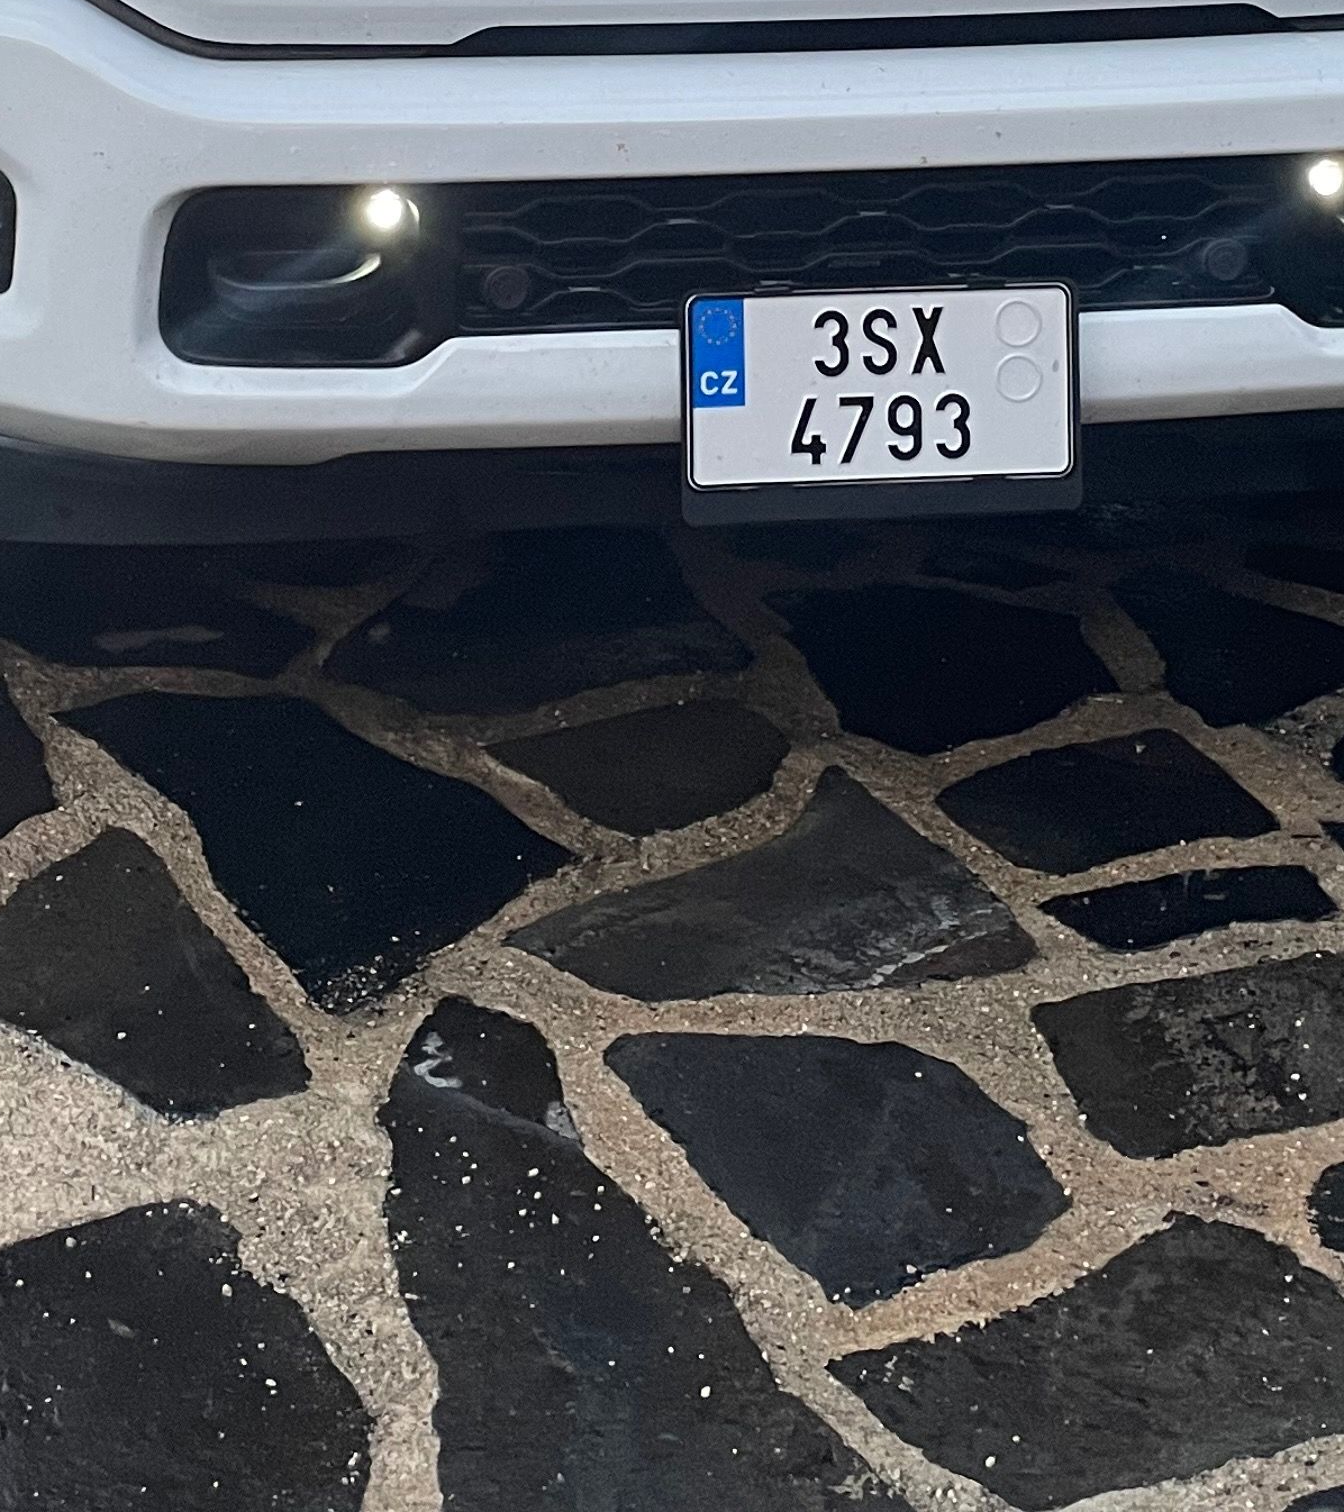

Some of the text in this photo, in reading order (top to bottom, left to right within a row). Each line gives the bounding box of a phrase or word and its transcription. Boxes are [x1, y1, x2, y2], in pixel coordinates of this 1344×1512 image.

[813, 306, 946, 377] 3SX
[700, 370, 738, 395] CZ
[790, 393, 972, 465] 4793
